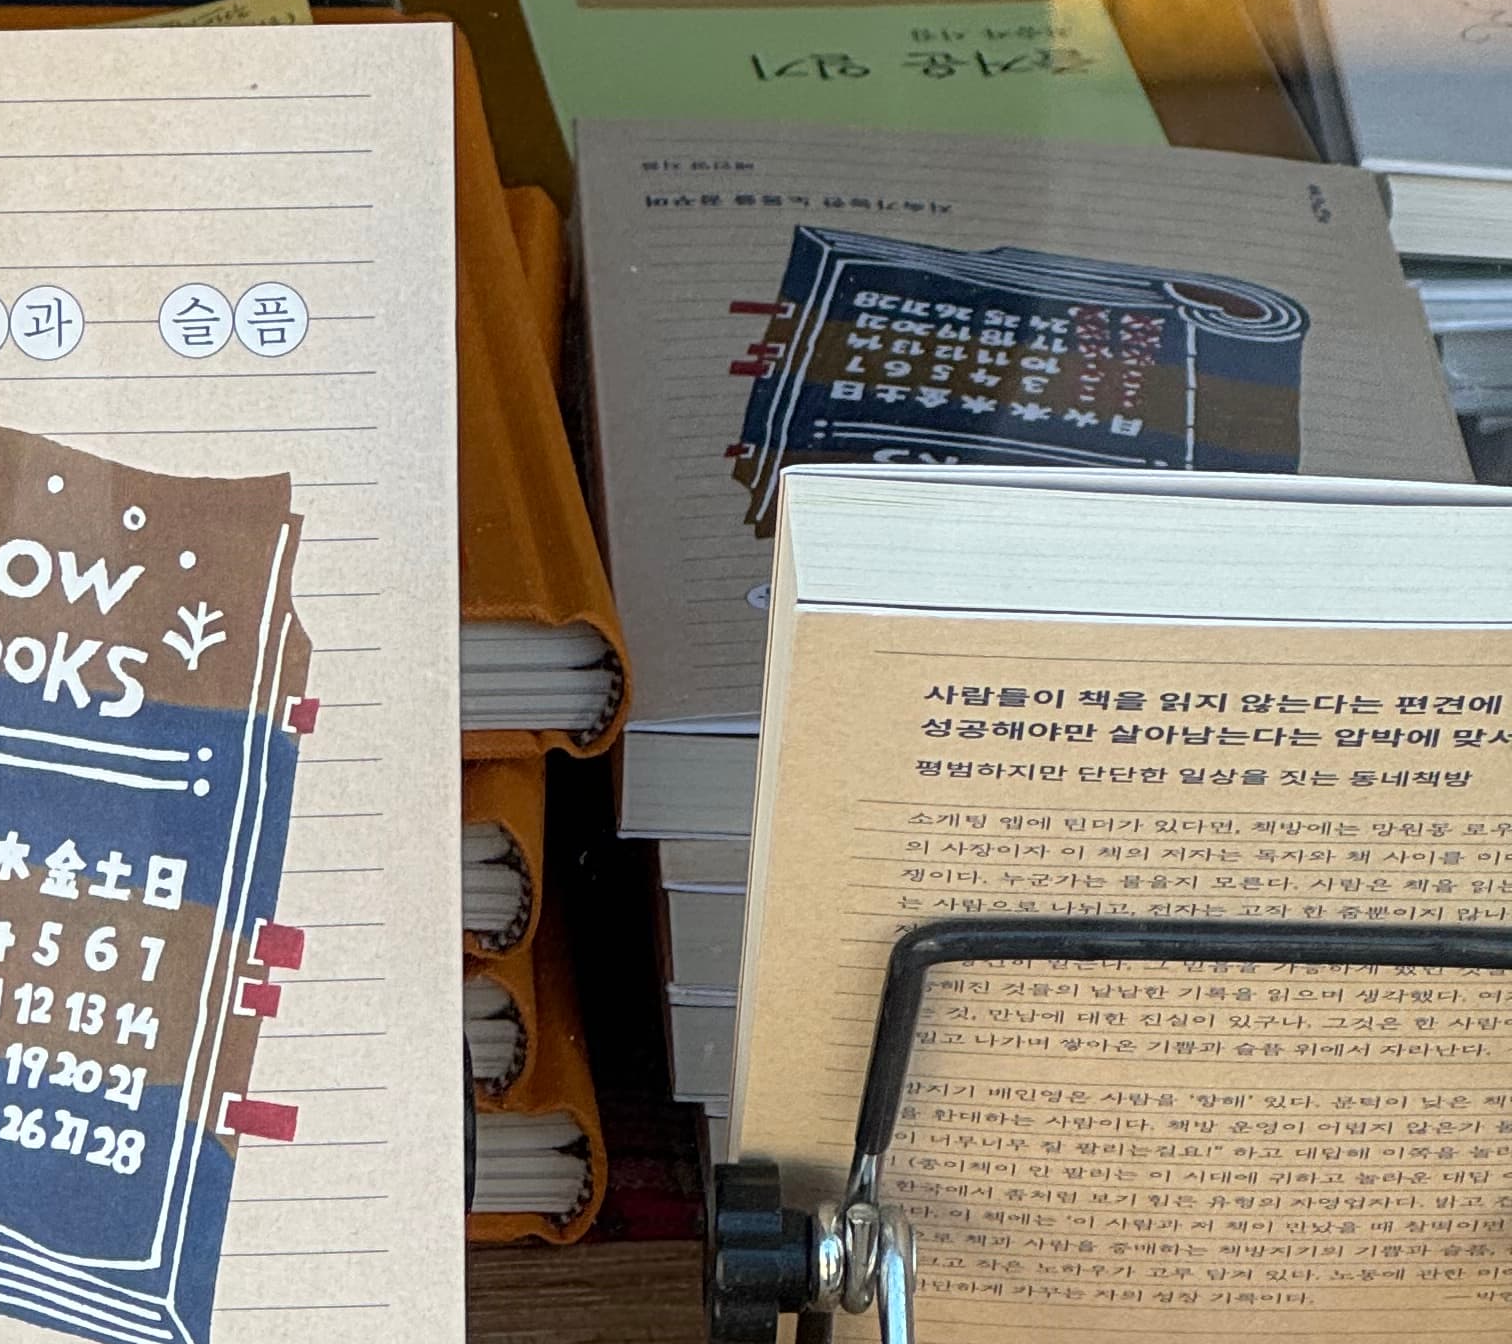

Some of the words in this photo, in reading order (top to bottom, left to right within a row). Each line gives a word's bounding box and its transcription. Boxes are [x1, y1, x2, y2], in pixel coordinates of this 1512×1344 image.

[165, 290, 302, 353] 슬픔
[853, 291, 901, 310] 28
[935, 303, 974, 321] 26
[983, 310, 1021, 328] 25
[1029, 315, 1070, 334] 24
[856, 312, 890, 330] 21
[891, 319, 936, 337] 20
[938, 323, 971, 342] 19
[980, 328, 1017, 347] 18
[1030, 335, 1068, 355] 17
[846, 332, 883, 351] 14
[891, 339, 925, 356] 13
[935, 345, 968, 362] 12
[976, 349, 1010, 367] 11
[1020, 356, 1061, 375] 10
[845, 355, 866, 374] 7
[883, 360, 912, 378] 6
[930, 364, 954, 382] 5
[969, 368, 1002, 387] 4
[1020, 375, 1049, 394] 3
[924, 685, 1065, 709] 사람들이
[1078, 689, 1147, 713] 책을
[1159, 691, 1227, 714] 읽지
[1241, 693, 1382, 715] 않는다는
[1396, 694, 1502, 717] 편견에
[921, 718, 1096, 743] 성공해야만
[1109, 722, 1322, 747] 살아남는다는
[1334, 726, 1439, 749] 압박에
[914, 759, 1067, 782] 평범하지만
[1077, 762, 1168, 785] 단단한
[1180, 765, 1270, 786] 일상을
[1281, 767, 1338, 787] 짓는
[1350, 768, 1473, 789] 동네책방
[1252, 820, 1360, 836] 책방에는
[905, 840, 929, 855] 의
[1061, 845, 1084, 859] 이
[1160, 847, 1240, 863] 저자는
[1003, 872, 1107, 888] 누군가는
[31, 921, 63, 966] 5
[84, 926, 118, 971] 6
[140, 936, 165, 982] 7
[14, 983, 53, 1024] 12
[65, 991, 106, 1035] 13
[115, 1002, 160, 1049] 14
[989, 1008, 1065, 1024] 만남에
[1077, 1011, 1128, 1026] 대한
[1140, 1013, 1215, 1028] 진실이
[1322, 1016, 1402, 1031] 그것은
[975, 1032, 1049, 1049] 나가며
[1293, 1043, 1370, 1057] 위에서
[5, 1042, 48, 1089] 19
[49, 1051, 102, 1093] 20
[105, 1063, 147, 1111] 21
[0, 1105, 46, 1149] 26
[86, 1126, 146, 1174] 28
